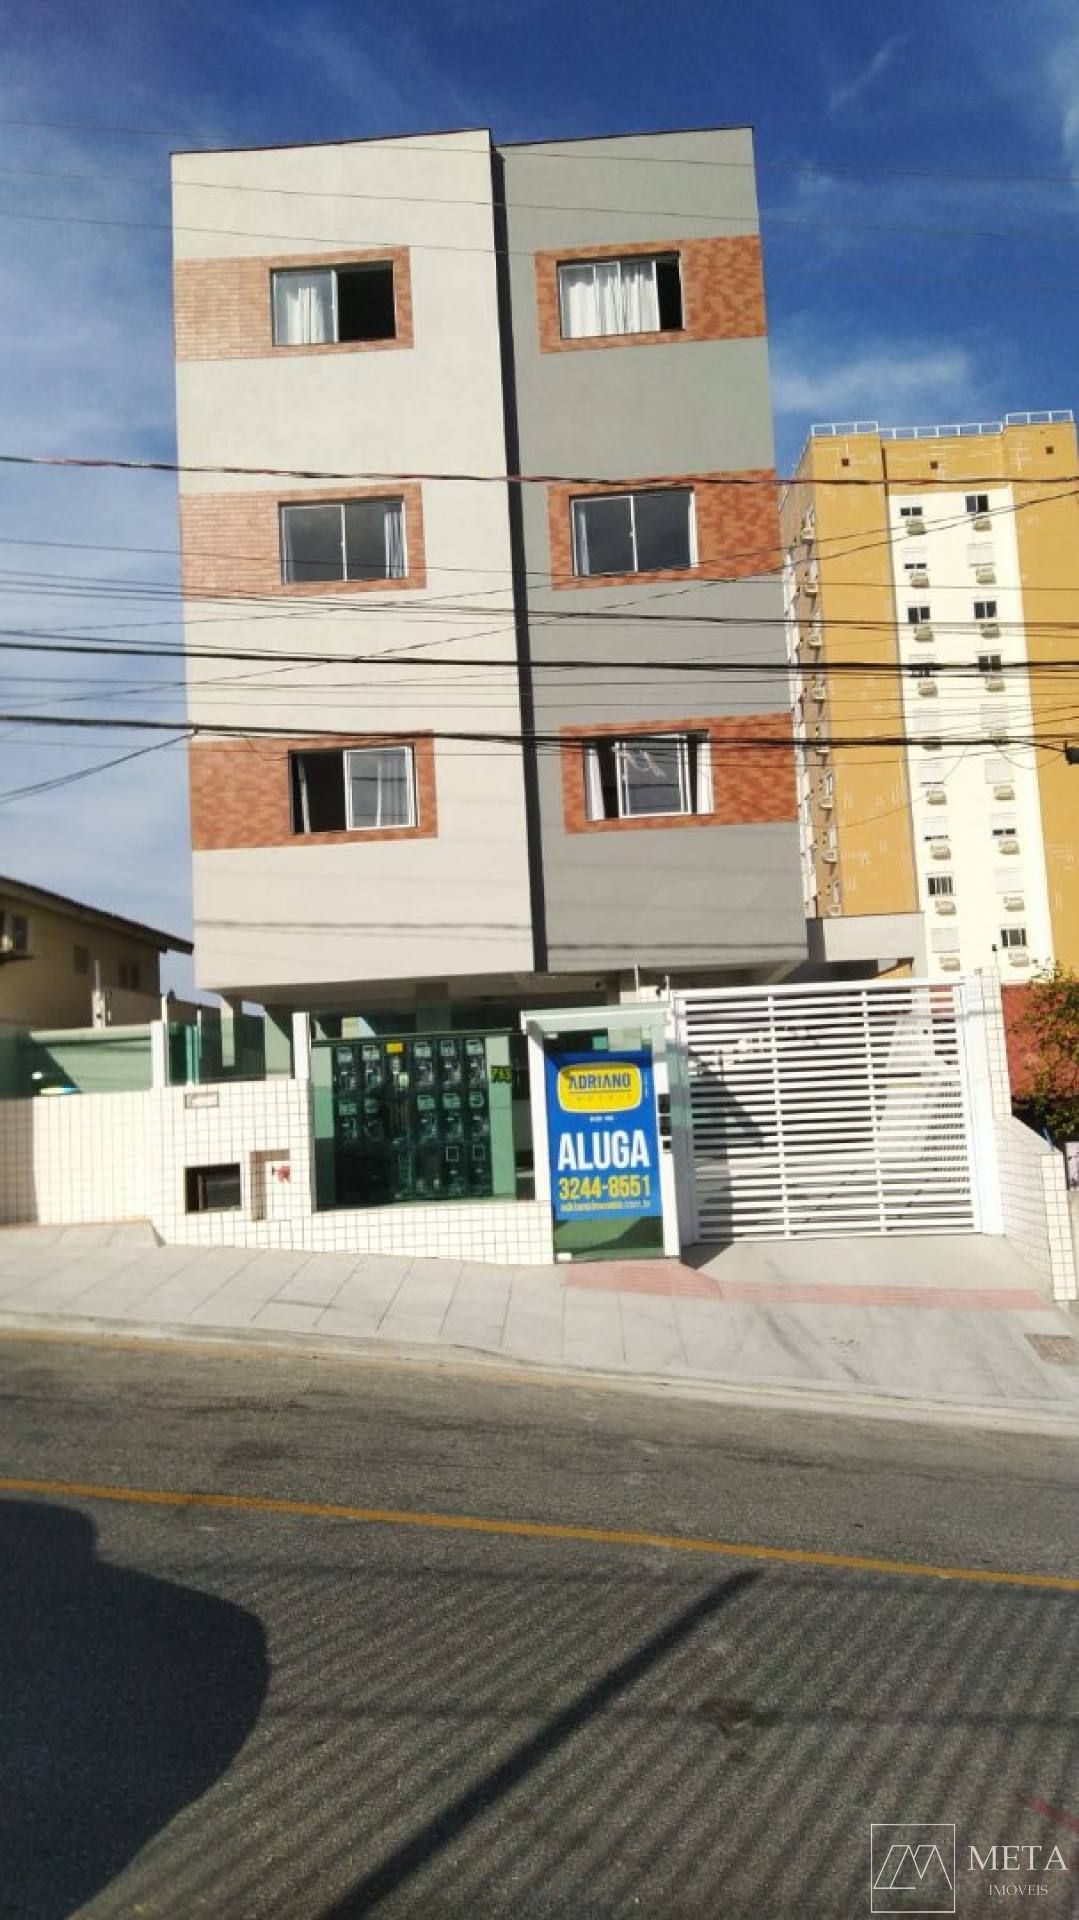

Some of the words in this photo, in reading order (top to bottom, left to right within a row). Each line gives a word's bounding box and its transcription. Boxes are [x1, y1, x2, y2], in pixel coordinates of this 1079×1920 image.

[569, 1073, 631, 1089] ADRIANO
[558, 1130, 650, 1170] ALUGA
[559, 1175, 650, 1199] 3244-8551
